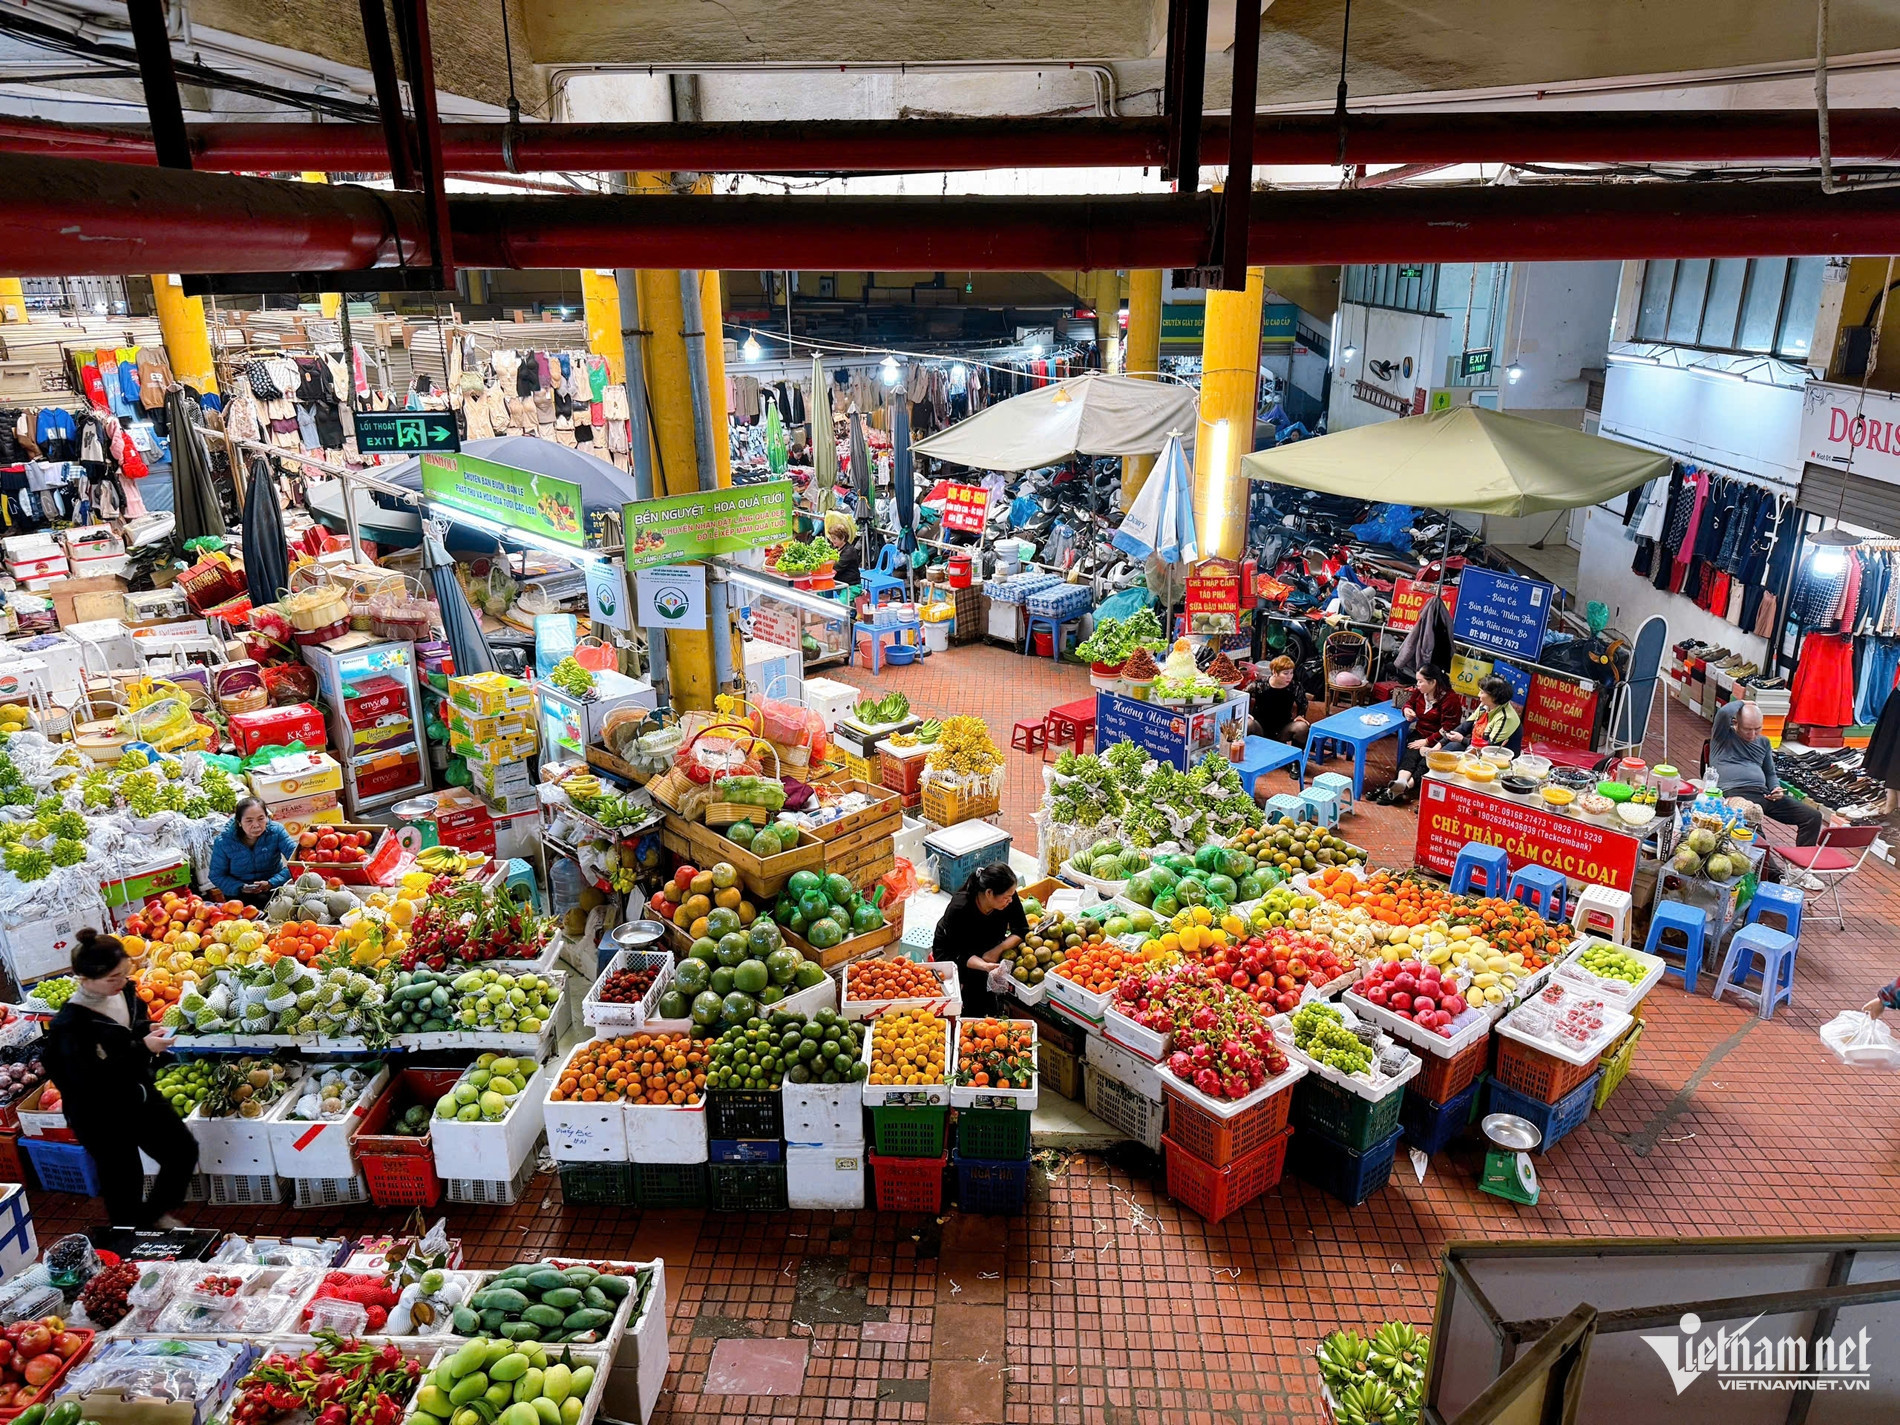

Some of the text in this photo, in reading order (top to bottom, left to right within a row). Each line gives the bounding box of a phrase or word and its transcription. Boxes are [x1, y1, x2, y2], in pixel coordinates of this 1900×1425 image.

[1469, 354, 1488, 364] EXIT
[360, 420, 396, 431] LỐI THOÁT
[366, 437, 394, 446] EXIT
[662, 503, 706, 521] NGUYỆT
[713, 501, 736, 514] HOA
[738, 495, 761, 511] QUẢ
[762, 492, 785, 506] TƯƠI
[662, 524, 694, 536] CHUYÊN
[754, 510, 770, 521] QUẢ
[1495, 579, 1509, 590] Bún
[1398, 592, 1423, 608] ĐẶC
[1468, 600, 1482, 612] Bún
[1492, 592, 1517, 607] Bún Cá
[1470, 615, 1484, 627] Bún
[1469, 628, 1479, 638] ĐT:
[1479, 631, 1491, 641] 091
[1503, 637, 1520, 650] 7473
[1457, 670, 1474, 683] 60
[360, 698, 380, 711] envy
[1539, 693, 1583, 718] THẬP CẨM
[1146, 710, 1170, 728] Nộm
[303, 729, 321, 738] Apple
[1527, 711, 1590, 742] BÁNH BỘT LỌC
[372, 773, 390, 784] envy
[281, 804, 303, 813] PEARS
[1457, 805, 1472, 816] STK:
[1537, 829, 1592, 852] (Teckcombank)
[1472, 799, 1485, 809] chè
[1489, 803, 1501, 814] ĐT:
[1501, 807, 1523, 820] 09166
[1524, 813, 1547, 827] 27473
[1553, 822, 1572, 834] 0926
[1573, 828, 1582, 838] 11
[1584, 831, 1603, 844] 5239
[1430, 833, 1462, 849] CHÈ XANH
[1431, 814, 1618, 887] CHÈ THẬP CẨM CÁC LOẠI
[1428, 854, 1450, 866] THẠCH
